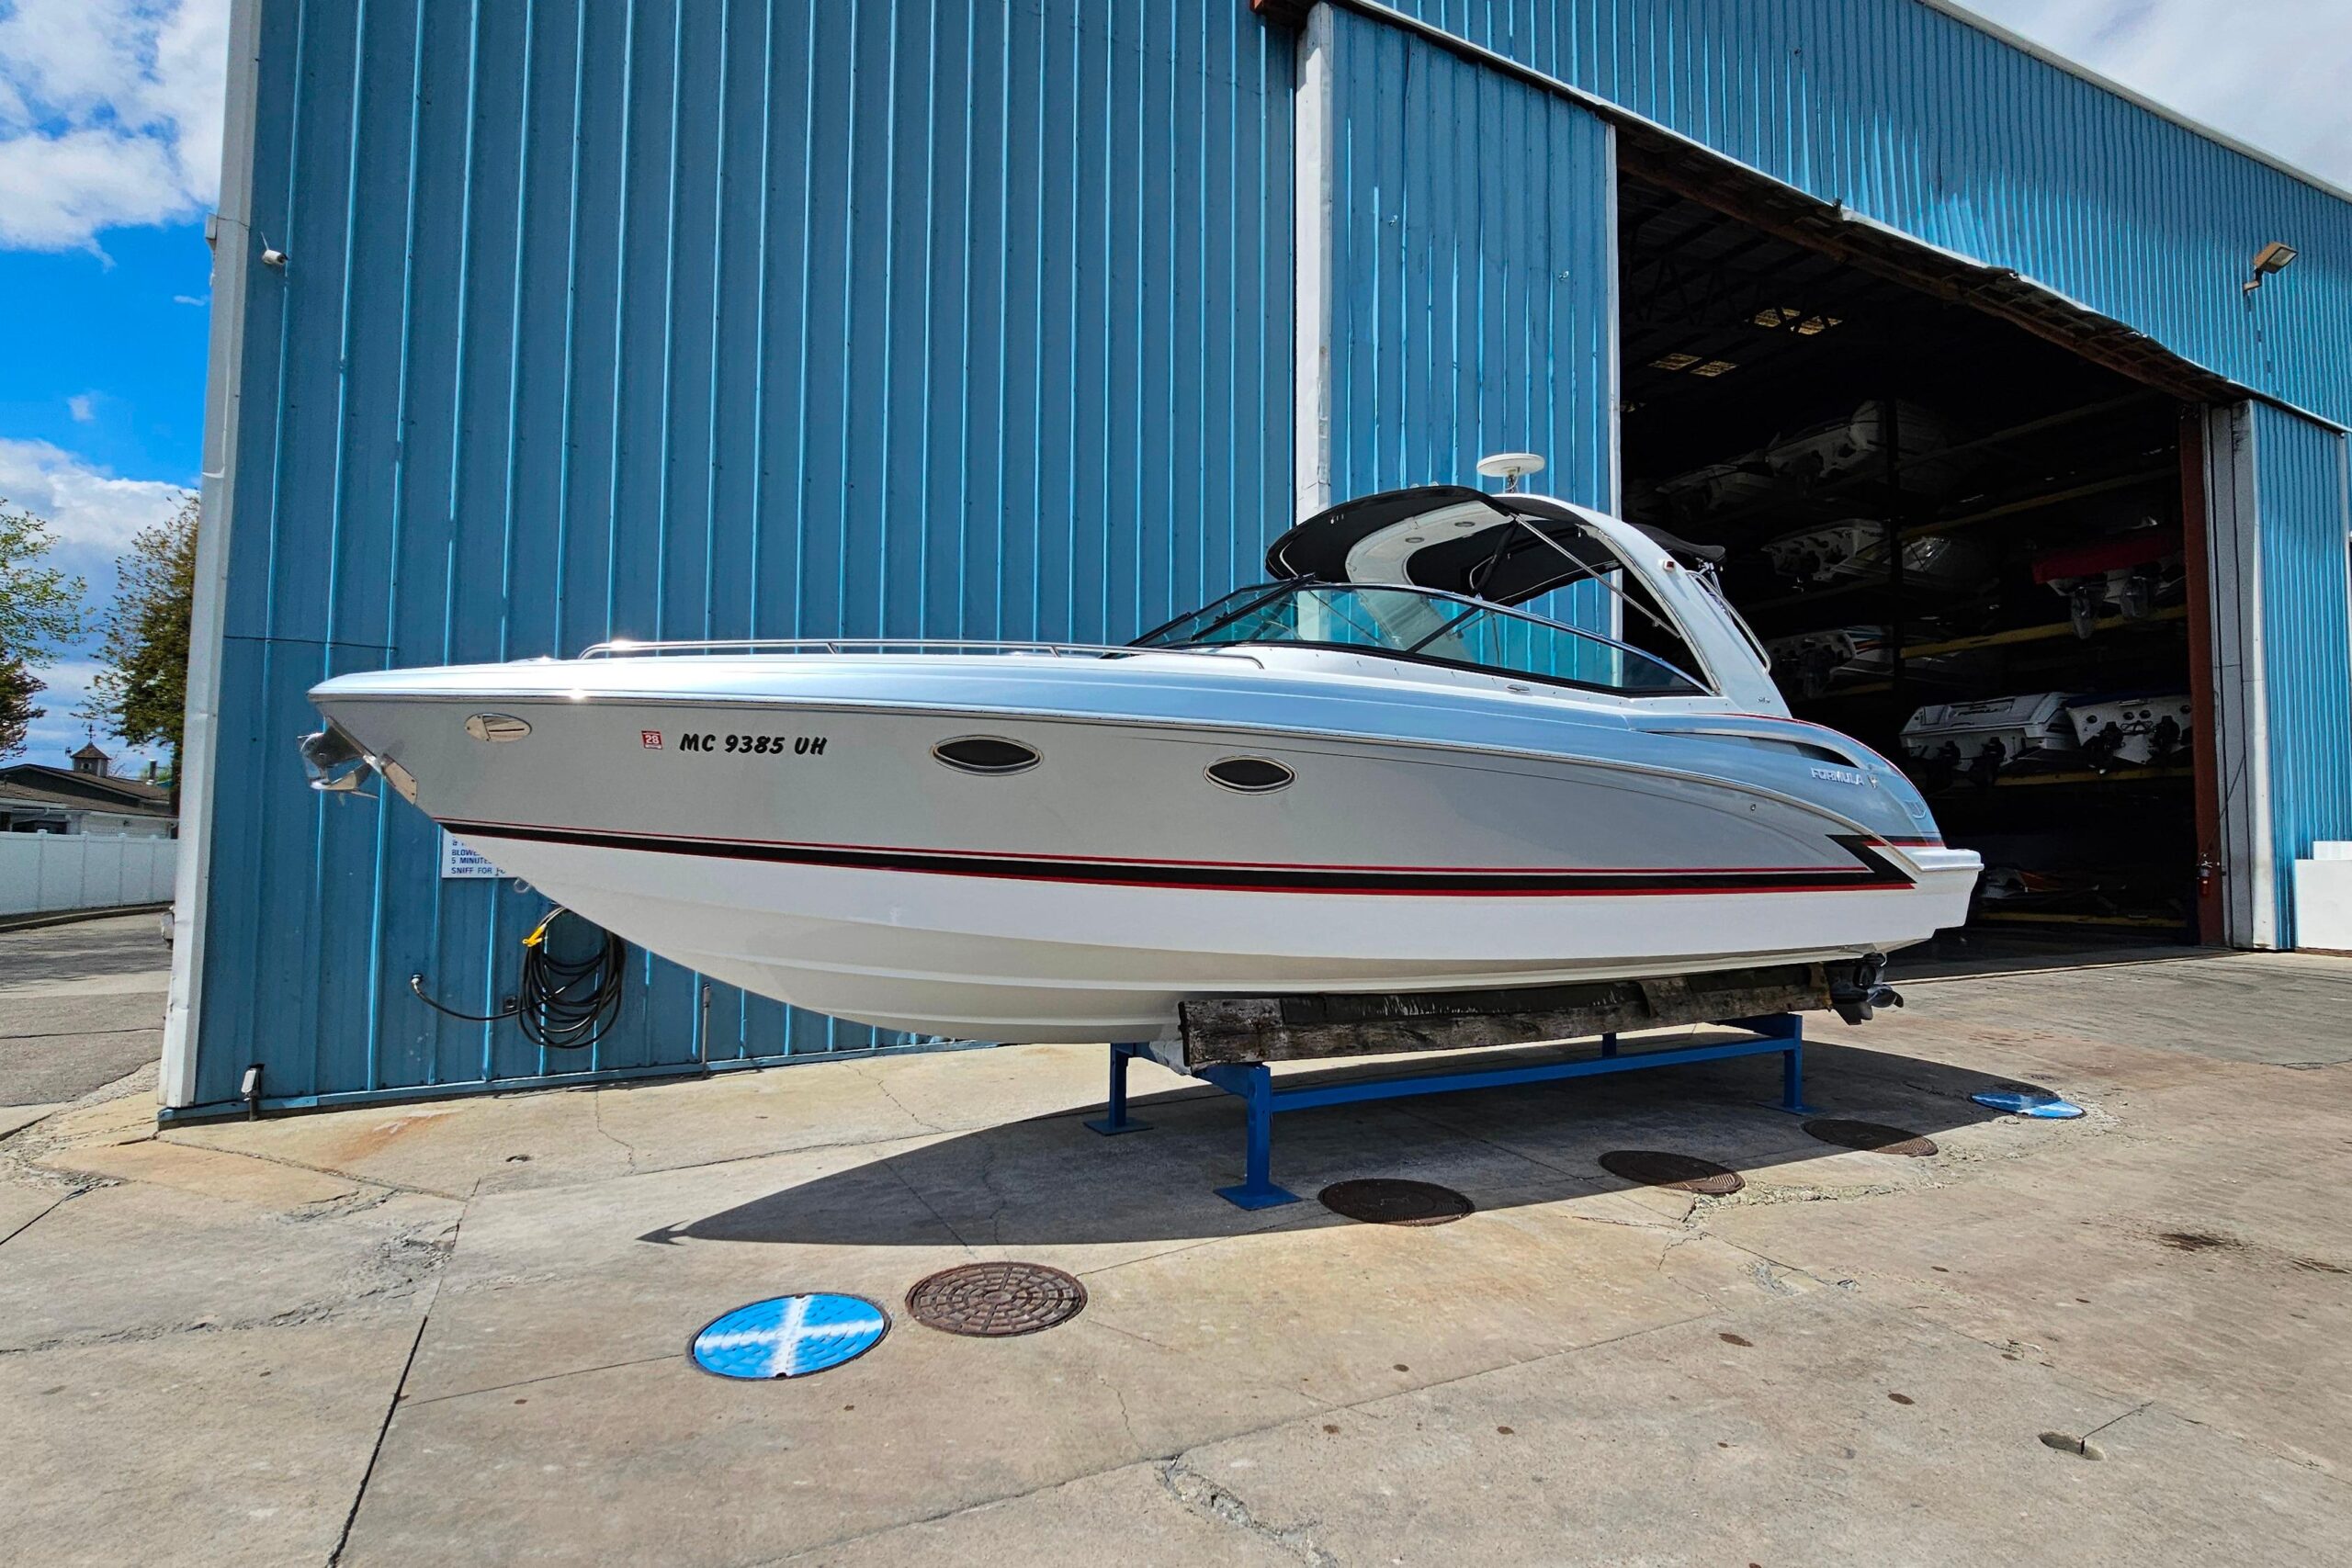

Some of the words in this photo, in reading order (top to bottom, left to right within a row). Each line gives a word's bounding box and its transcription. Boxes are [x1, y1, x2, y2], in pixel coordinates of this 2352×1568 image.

[646, 735, 660, 744] 28
[680, 733, 716, 751] MC
[725, 734, 785, 754] 9385
[795, 737, 827, 755] UH
[1811, 767, 1864, 785] FORMULA
